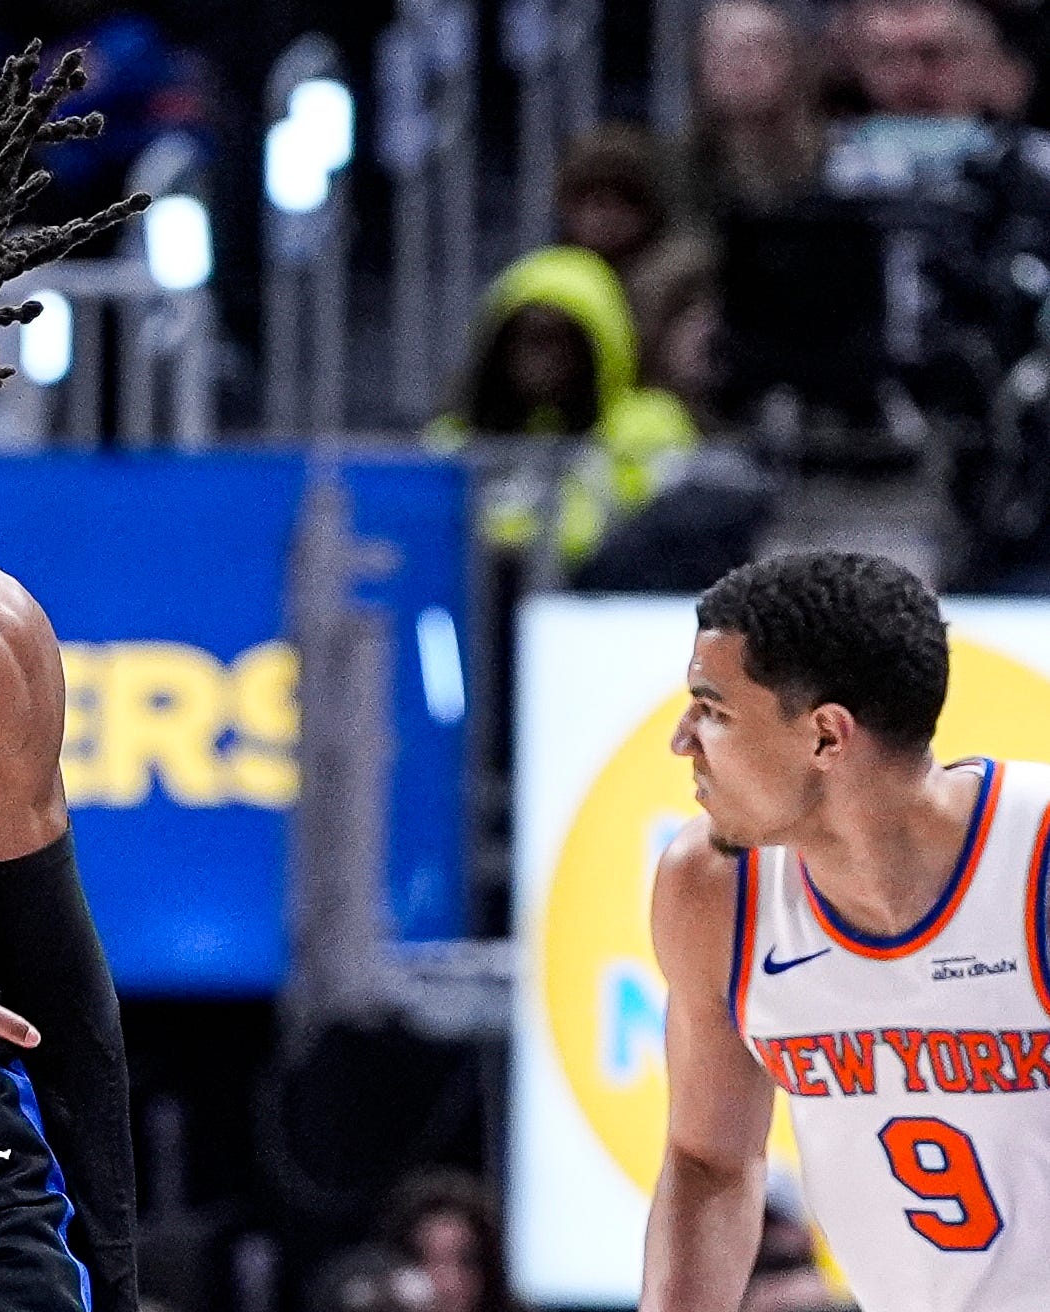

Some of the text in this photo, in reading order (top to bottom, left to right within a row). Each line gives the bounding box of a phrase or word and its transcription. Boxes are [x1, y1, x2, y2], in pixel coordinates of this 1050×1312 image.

[752, 1027, 1050, 1096] NEW YORK
[877, 1116, 1005, 1251] 9
